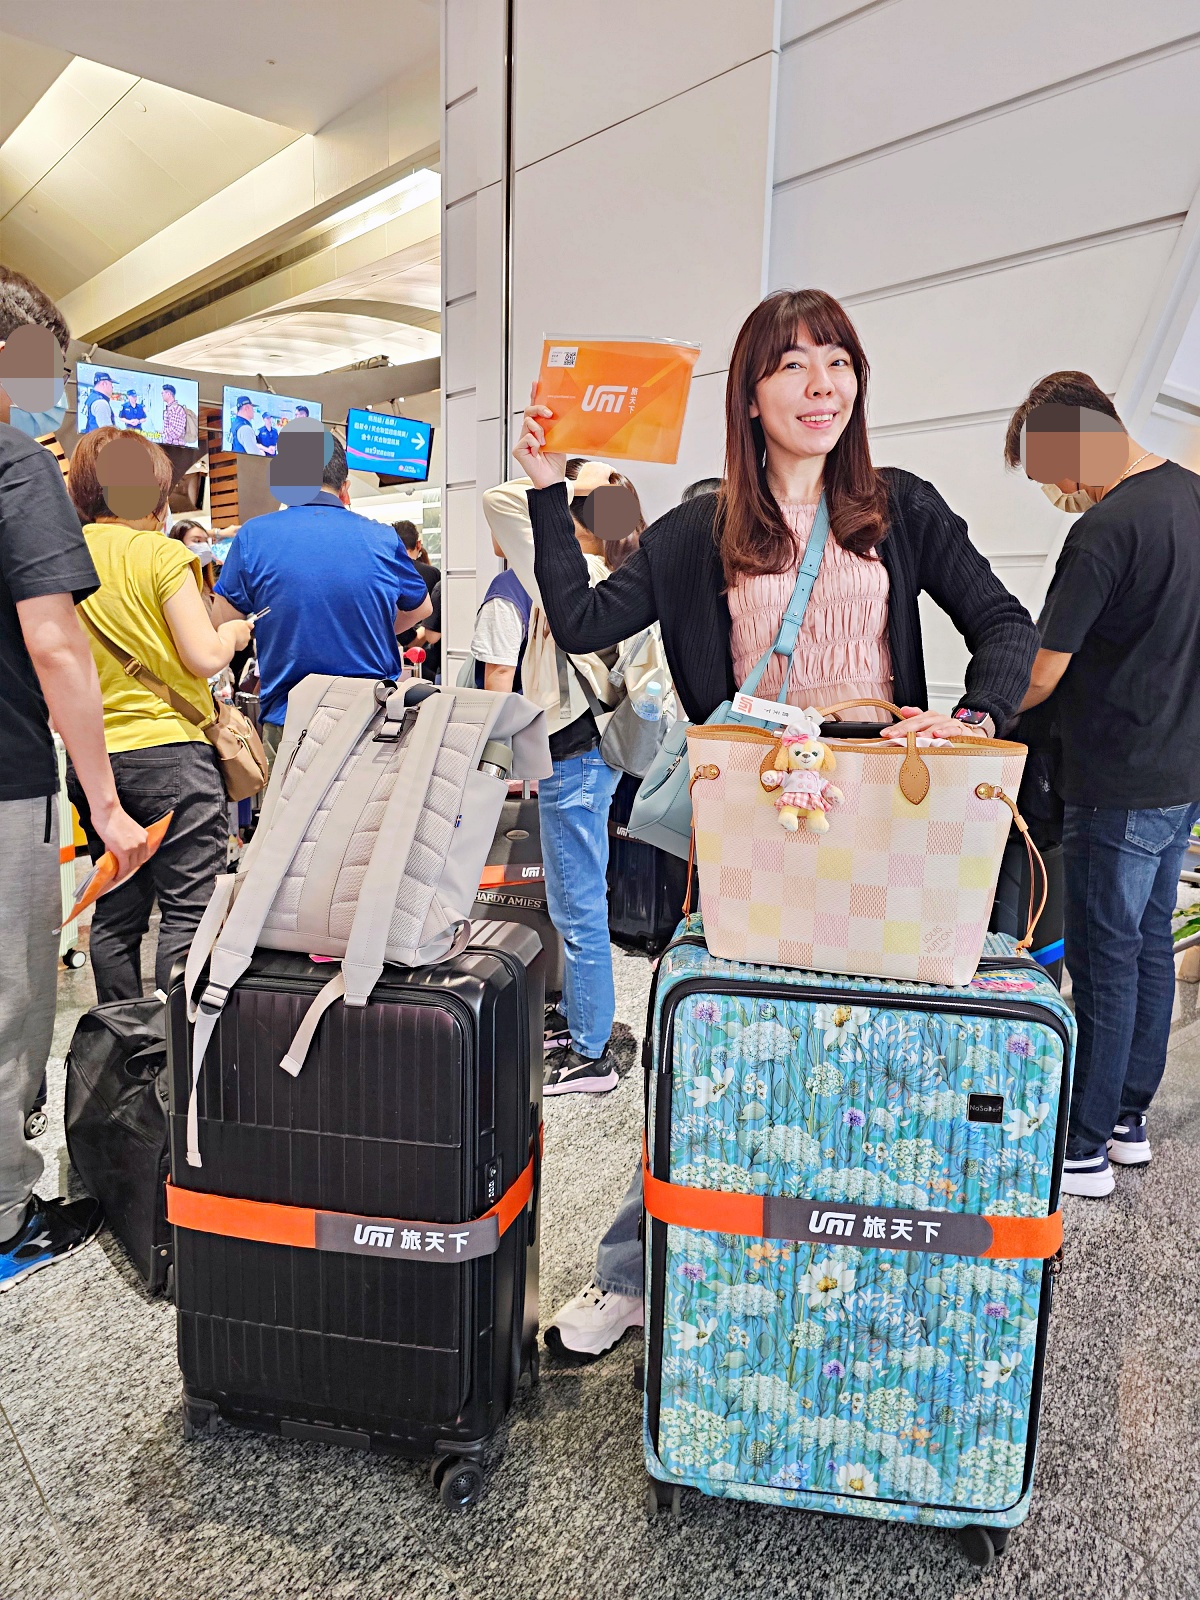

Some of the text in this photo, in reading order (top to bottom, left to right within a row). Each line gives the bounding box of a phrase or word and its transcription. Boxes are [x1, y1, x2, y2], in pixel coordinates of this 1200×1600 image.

[628, 387, 639, 414] 旅天下
[474, 892, 542, 908] HARDY AMIES
[922, 926, 942, 943] LOUIS
[924, 928, 954, 953] VUITTON
[400, 1228, 469, 1253] 旅天下
[862, 1215, 941, 1243] 旅天下
